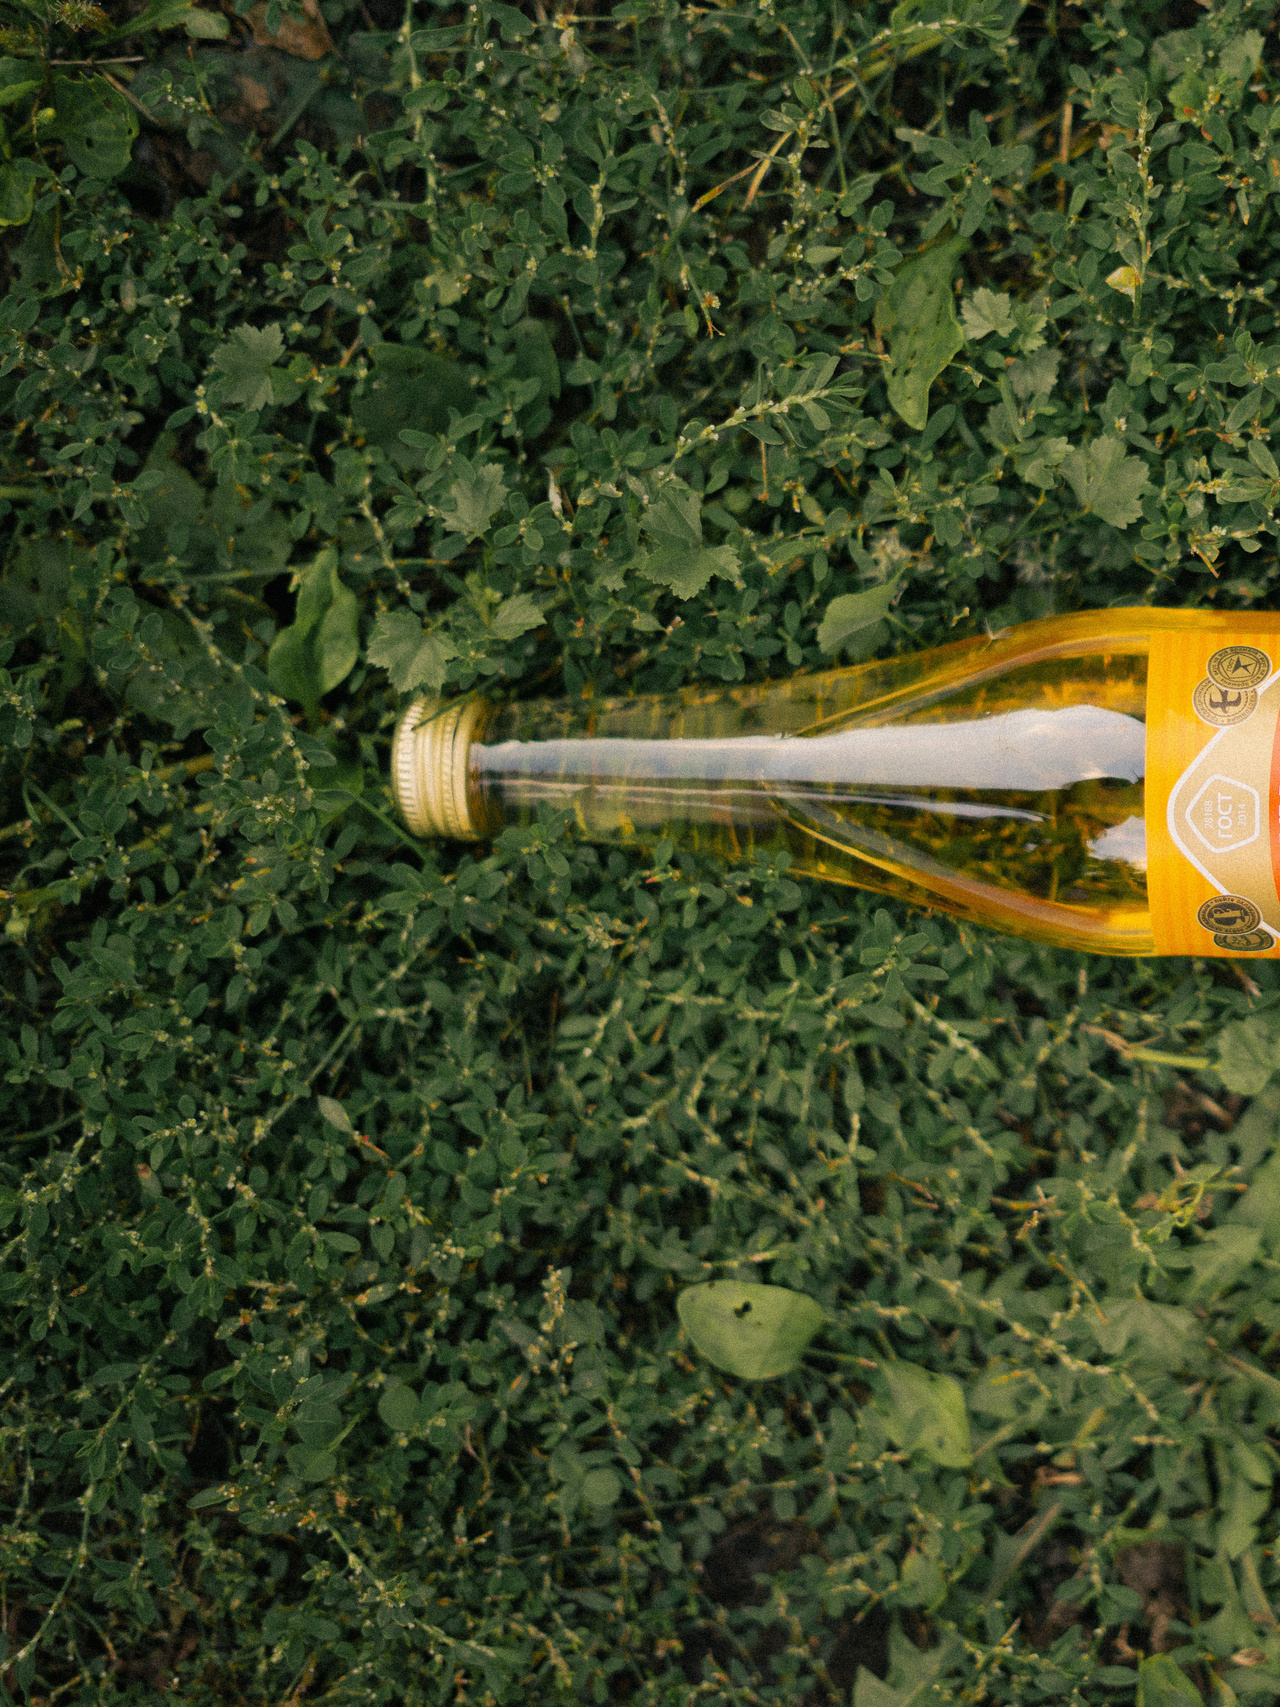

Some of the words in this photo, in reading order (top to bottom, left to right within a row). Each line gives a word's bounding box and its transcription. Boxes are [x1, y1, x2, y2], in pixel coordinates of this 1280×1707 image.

[1204, 800, 1213, 829] 28188
[1217, 791, 1233, 838] ГОСТ
[1237, 803, 1247, 826] 2014
